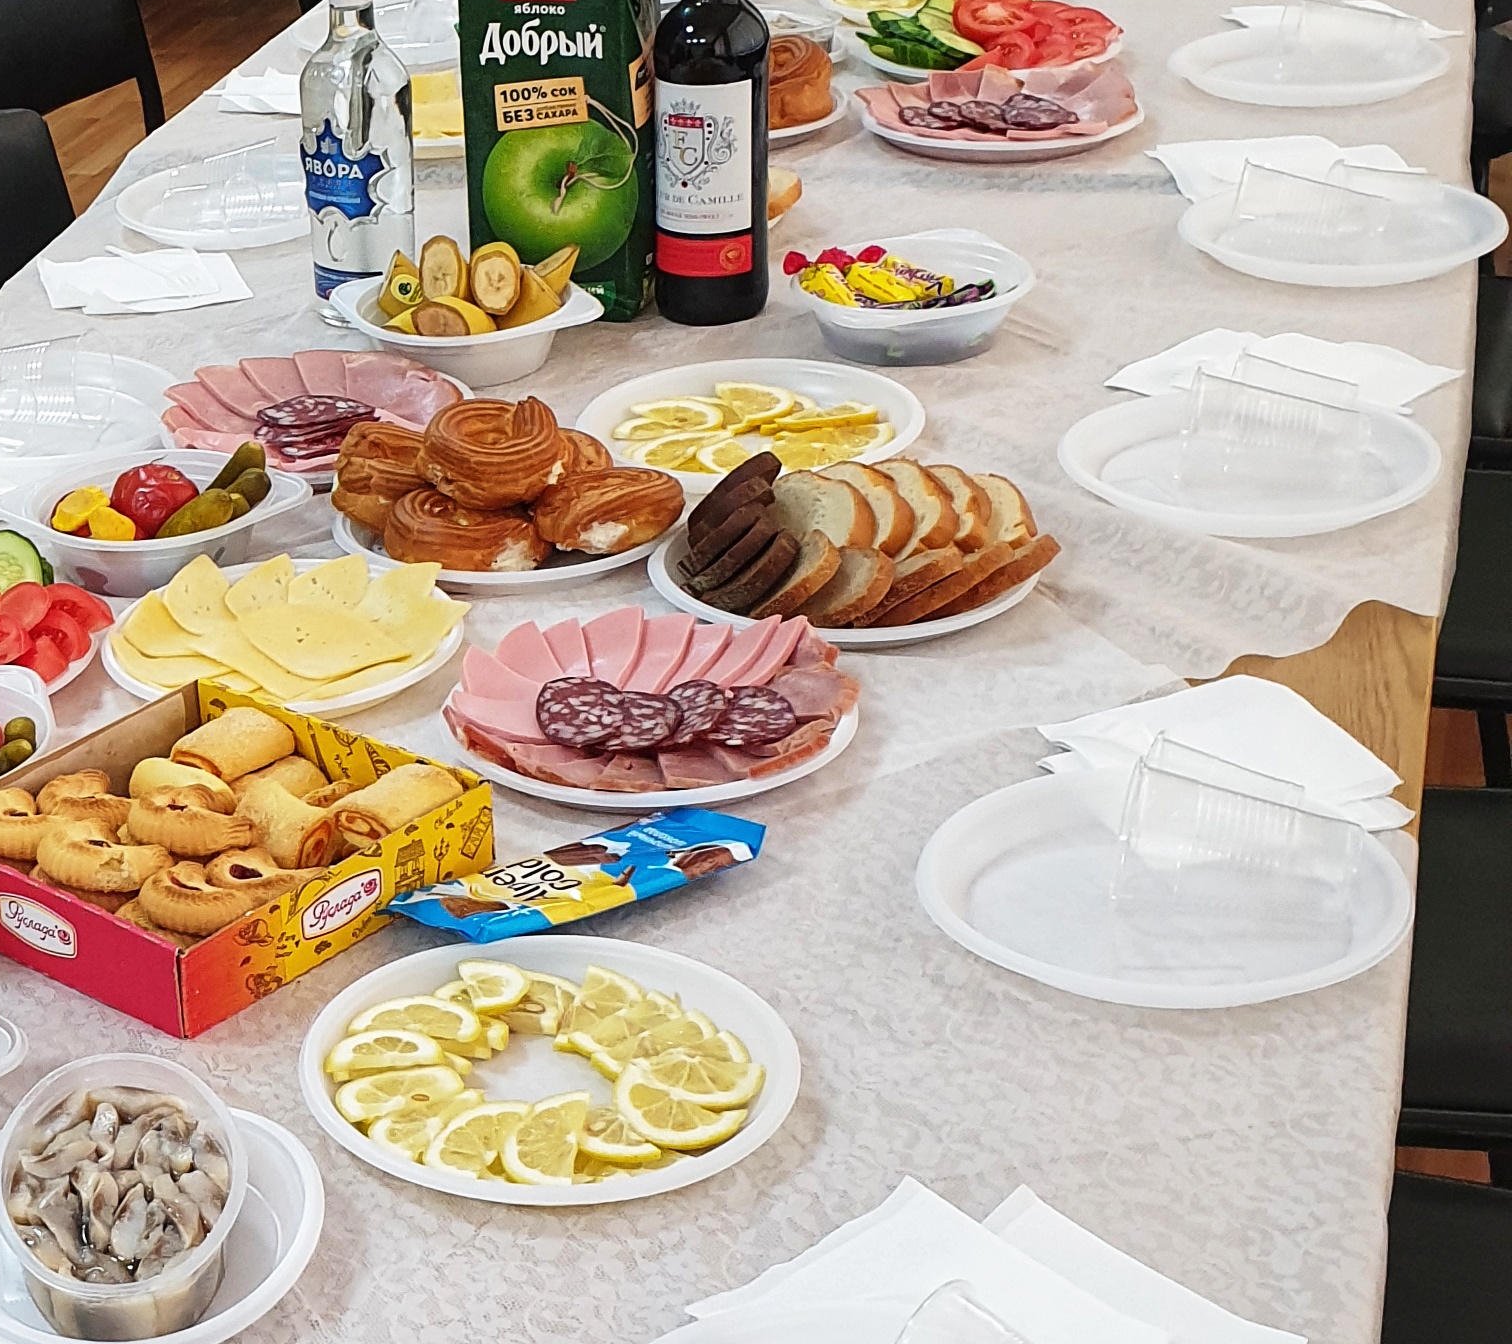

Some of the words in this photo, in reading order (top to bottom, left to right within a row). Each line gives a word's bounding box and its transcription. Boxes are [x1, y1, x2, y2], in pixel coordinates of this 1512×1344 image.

[514, 2, 566, 16] яблоко
[479, 18, 604, 66] Добрый
[500, 86, 548, 103] 100%
[502, 108, 535, 124] БЕЗ
[536, 108, 579, 120] САХАРА
[305, 157, 364, 179] ЯВОРА
[514, 858, 584, 892] Gold
